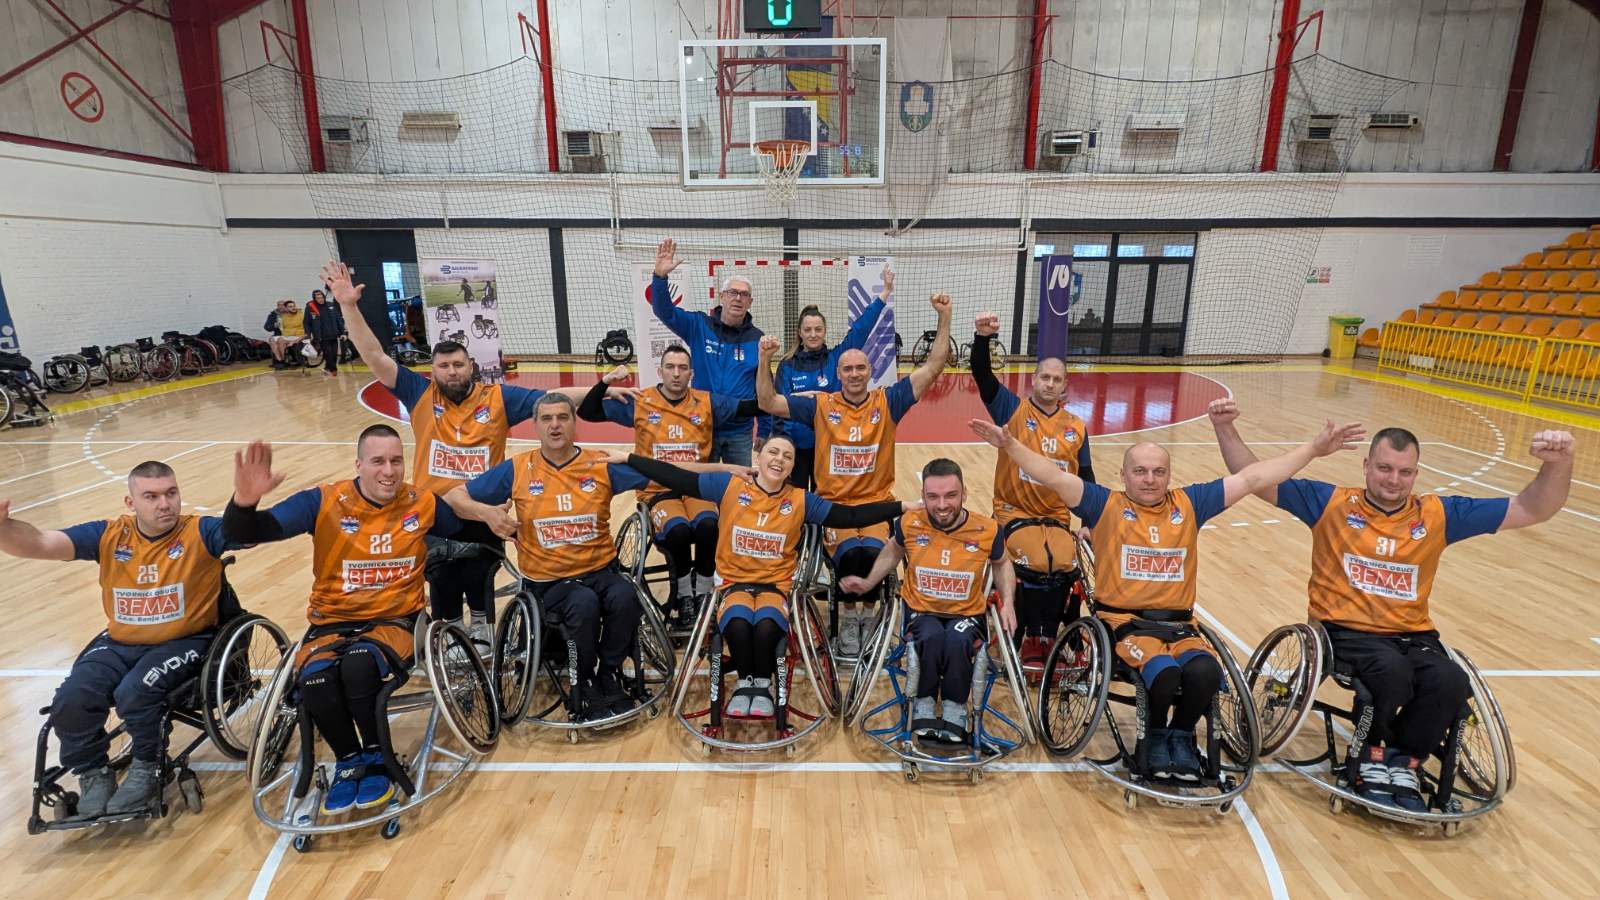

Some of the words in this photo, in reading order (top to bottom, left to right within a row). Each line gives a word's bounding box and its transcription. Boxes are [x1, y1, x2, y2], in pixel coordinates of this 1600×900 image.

[668, 424, 684, 440] 24
[849, 426, 862, 442] 21
[434, 451, 484, 471] BEMA
[556, 493, 573, 511] 15
[541, 524, 593, 541] BEMA
[1149, 526, 1160, 544] 6
[369, 533, 392, 555] 22
[736, 536, 778, 553] BEMA
[1376, 536, 1396, 558] 31
[941, 549, 951, 566] 5
[1127, 555, 1179, 572] BEMA
[137, 564, 159, 585] 25
[349, 568, 410, 585] BEMA
[1350, 564, 1409, 591] BEMA
[920, 575, 967, 593] BEMA
[119, 596, 177, 615] BEMA
[143, 649, 200, 687] GIVOVA
